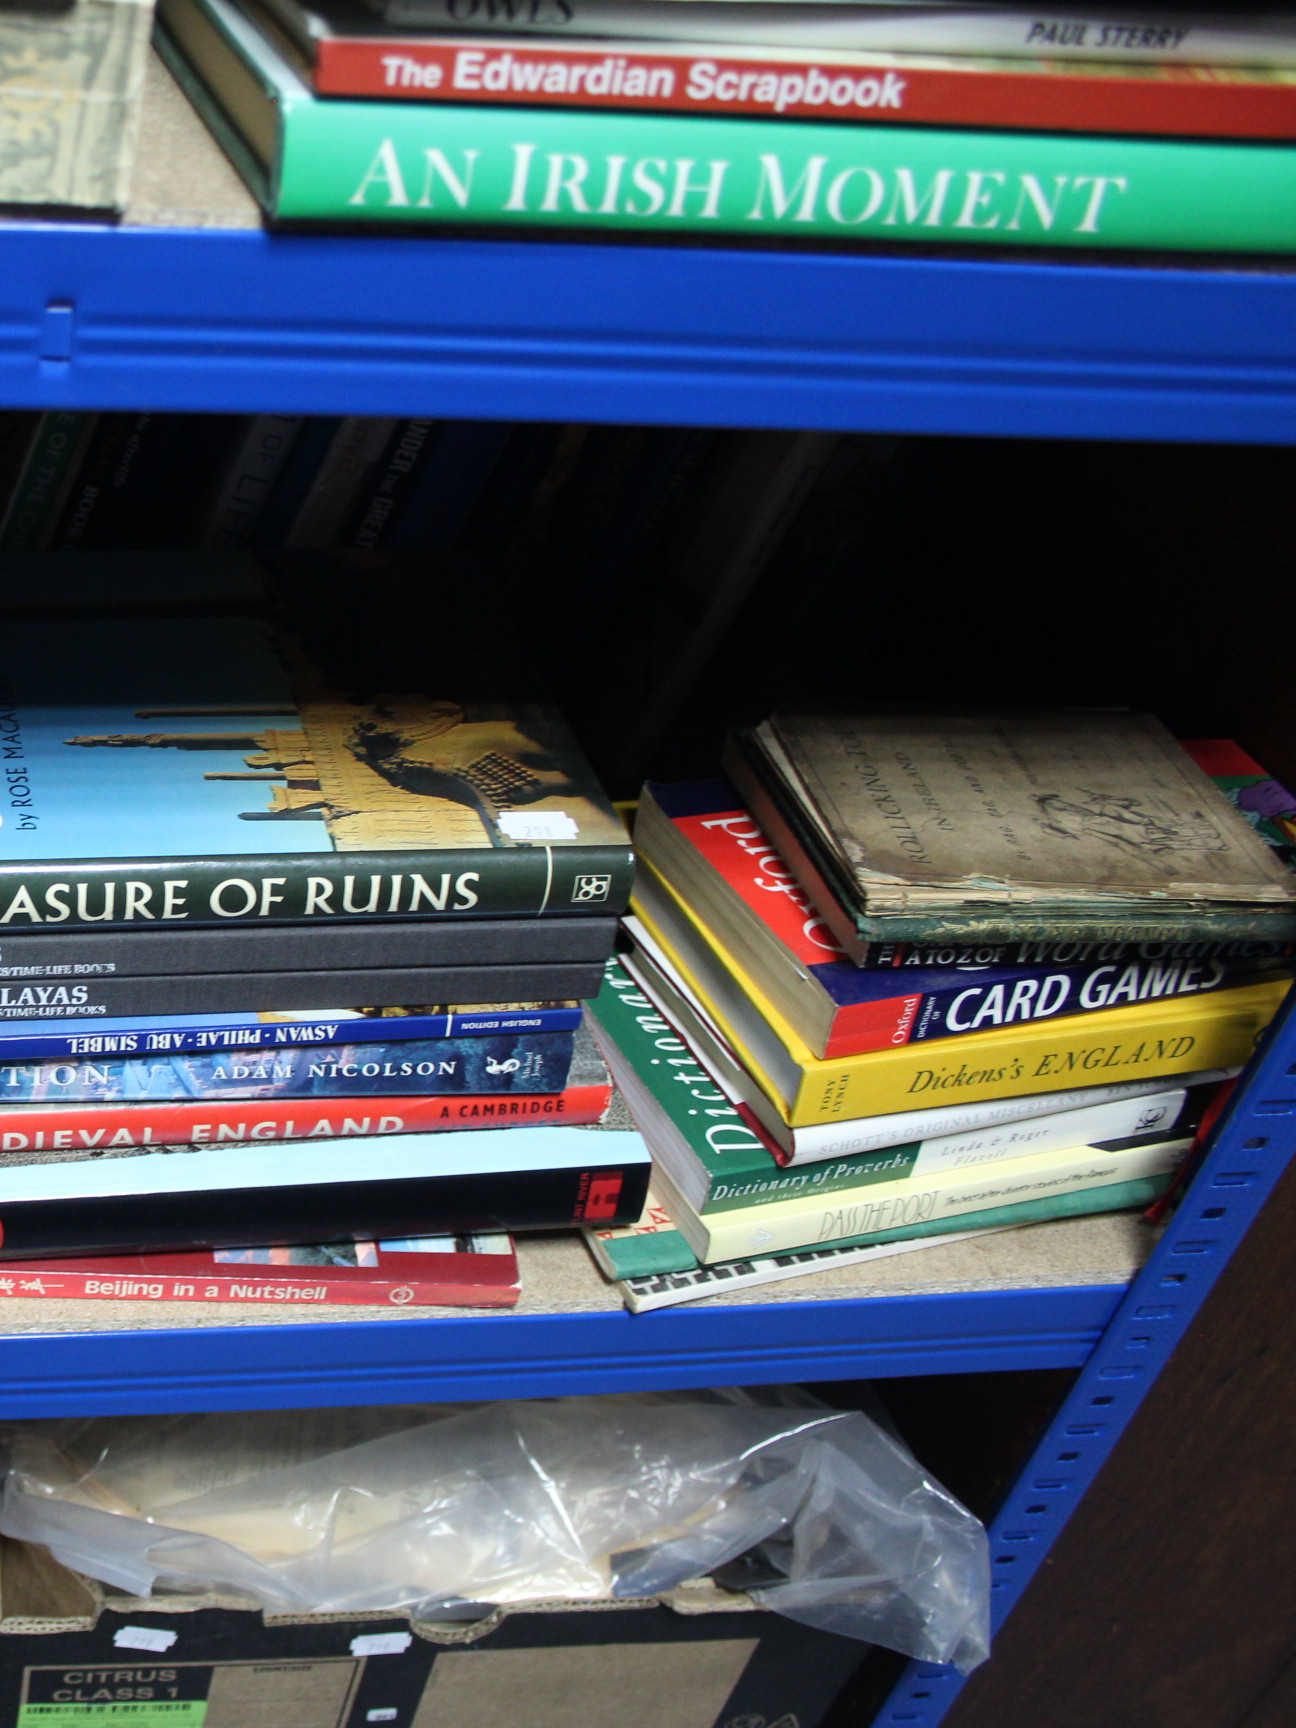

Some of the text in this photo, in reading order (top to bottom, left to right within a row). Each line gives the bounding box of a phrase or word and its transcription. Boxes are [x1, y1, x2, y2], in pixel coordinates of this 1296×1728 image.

[1025, 21, 1189, 50] PAUL STERRY
[381, 51, 910, 112] The Edwardian Scrapbook
[347, 138, 1128, 234] AN IRISH MOMENT
[5, 766, 33, 807] ROSE
[15, 811, 39, 831] by
[208, 876, 287, 917] OF
[303, 872, 481, 915] RUINS
[945, 956, 1225, 1031] CARD GAMES
[461, 1018, 543, 1031] ENGLISH EDITION
[891, 997, 918, 1044] Oxford
[917, 996, 936, 1039] DICTIONARY
[932, 1007, 942, 1020] OF
[66, 1023, 339, 1054] ASWAN PHILAE ABU SIMBEL
[211, 1065, 294, 1082] ADAM
[308, 1060, 459, 1079] NICOLSON
[905, 1035, 1198, 1094] Dickens's ENGLAND
[440, 1100, 566, 1118] A CAMBRIDGE
[819, 1081, 836, 1112] TONY
[833, 1074, 851, 1114] LYNCH
[191, 1115, 406, 1143] ENGLAND
[818, 1130, 898, 1156] SCHOTT'S
[903, 1114, 983, 1139] ORIGINAL
[940, 1139, 983, 1158] Linda
[1008, 1127, 1050, 1147] Roger
[712, 1154, 910, 1201] Dictionary of Proverbs
[817, 1190, 940, 1241] PASS THE PORT
[84, 1280, 327, 1300] Beijing in a Nutshell
[62, 1668, 178, 1685] CITRUS
[51, 1686, 179, 1702] CLASS 1
